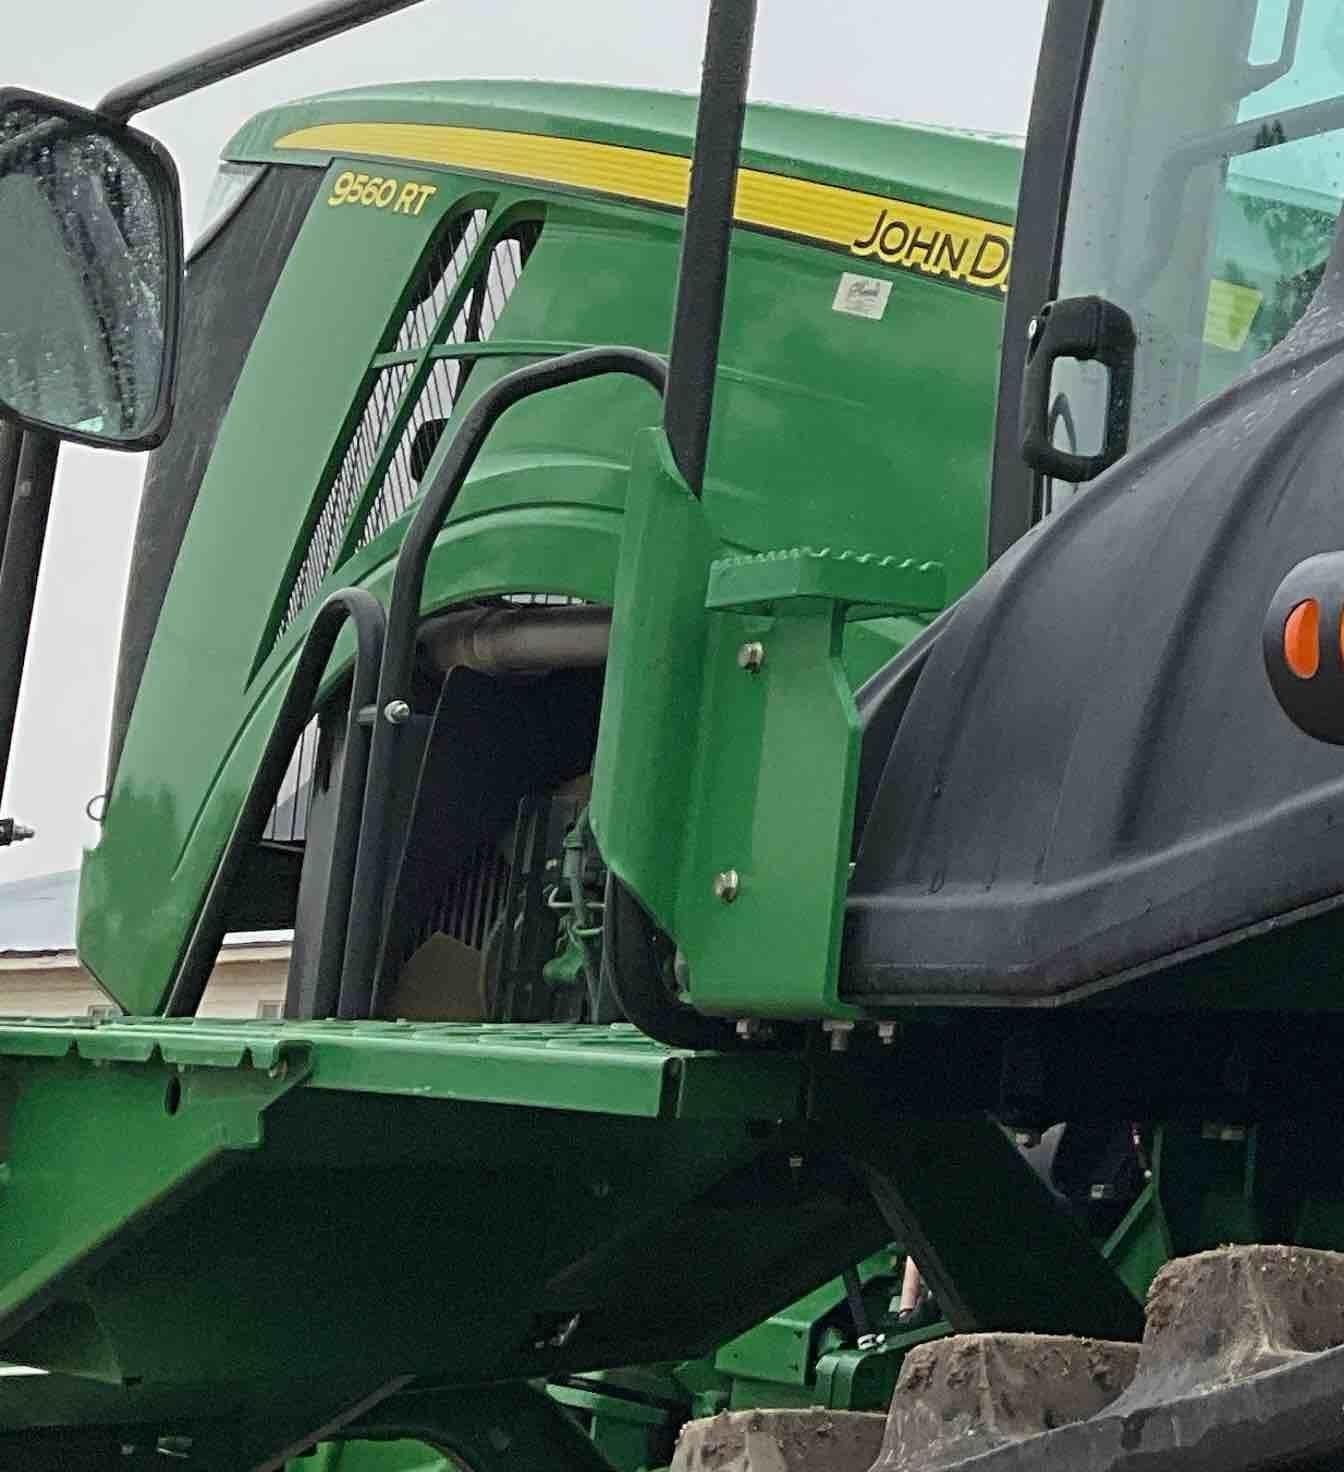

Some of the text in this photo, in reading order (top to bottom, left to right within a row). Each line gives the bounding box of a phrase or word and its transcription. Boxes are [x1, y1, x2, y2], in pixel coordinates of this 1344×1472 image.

[327, 171, 437, 216] 9560 RT
[851, 208, 1010, 285] JOHN D
